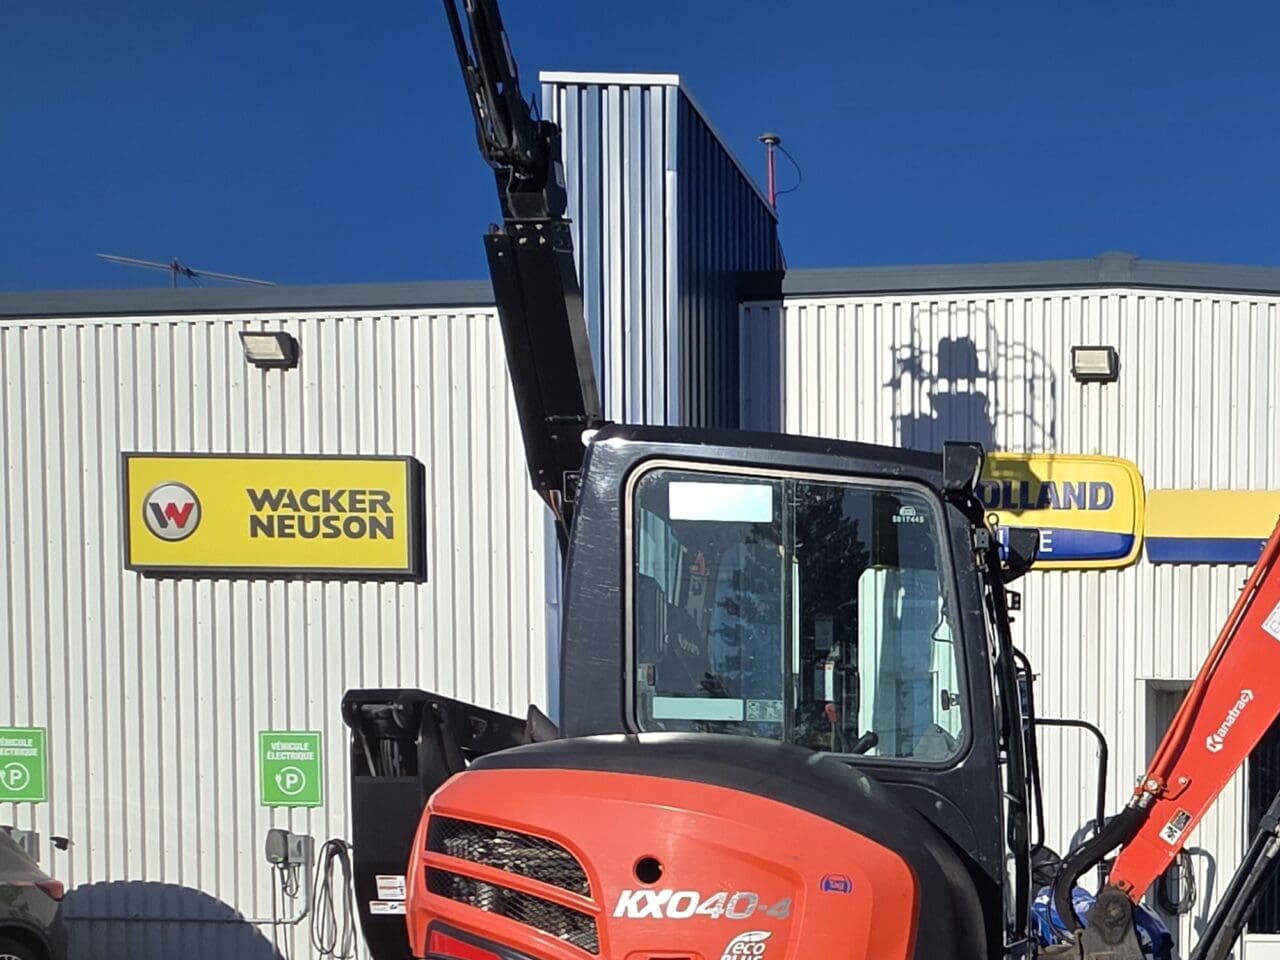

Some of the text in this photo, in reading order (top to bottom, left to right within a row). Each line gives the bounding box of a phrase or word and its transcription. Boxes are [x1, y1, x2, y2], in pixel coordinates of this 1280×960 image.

[246, 488, 394, 513] WACKER
[976, 480, 1114, 511] OLLAND
[249, 514, 395, 540] NEUSON
[1206, 689, 1254, 752] Kanatrac
[734, 941, 766, 956] eco
